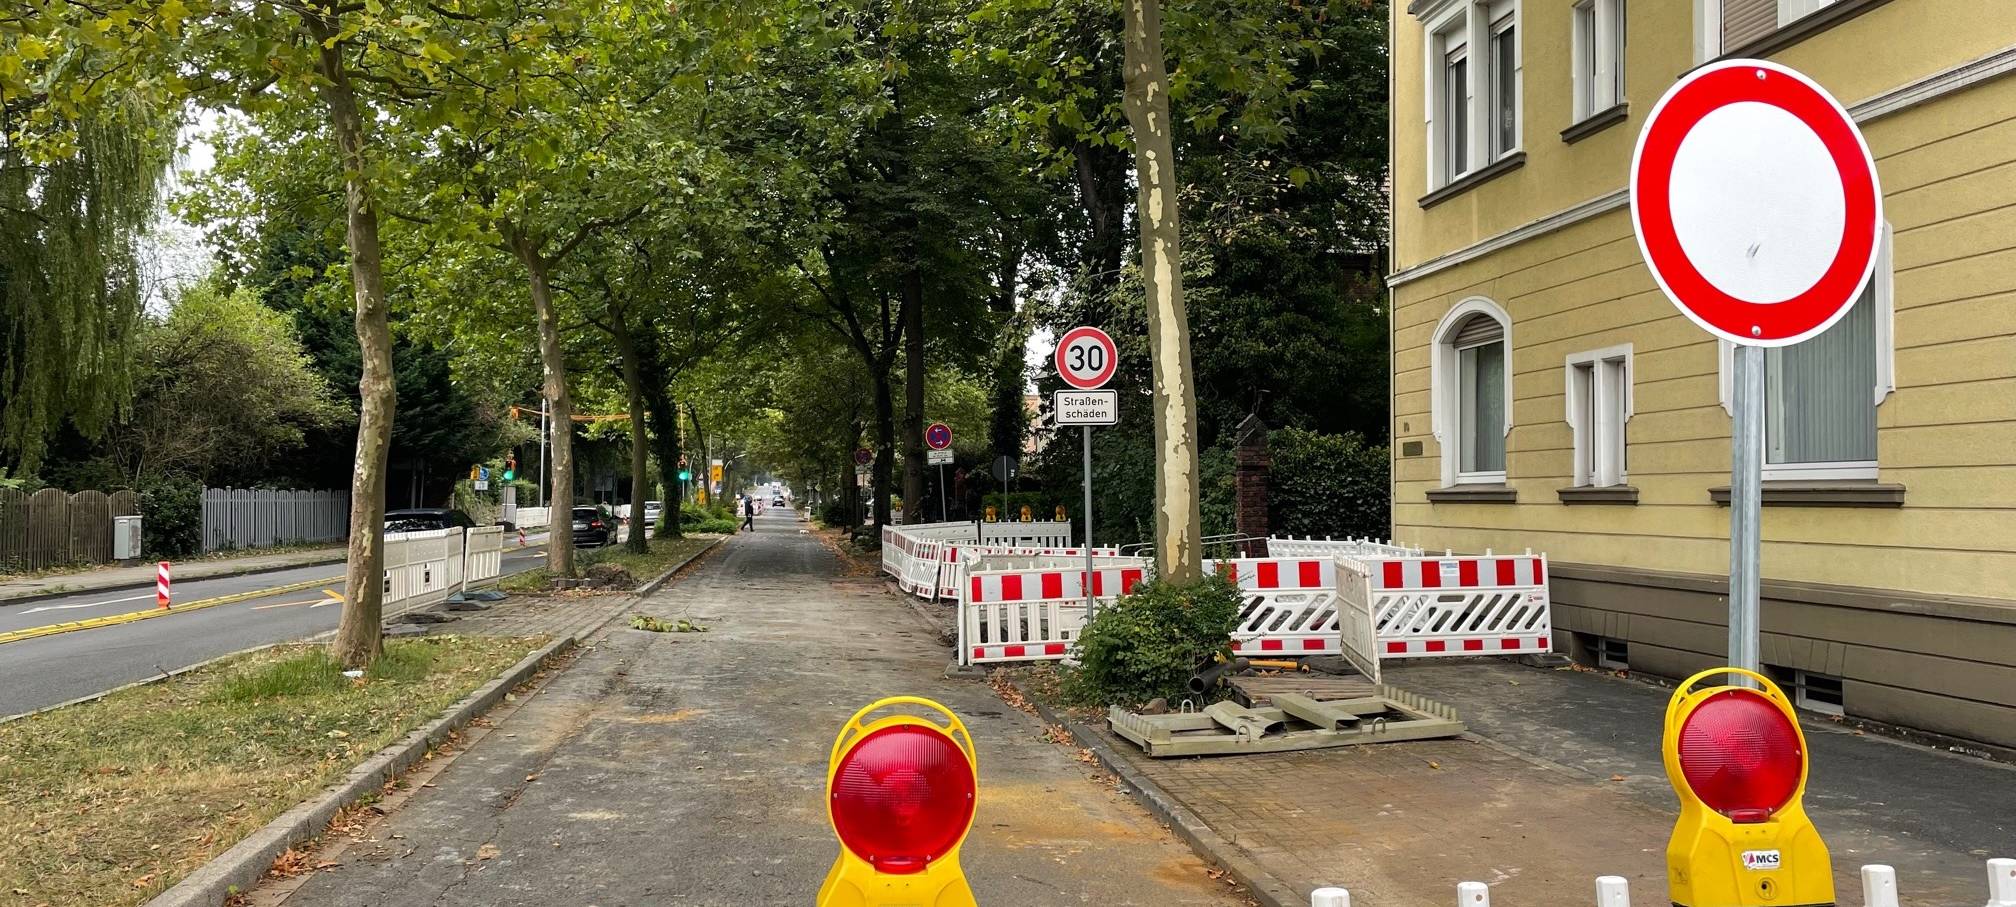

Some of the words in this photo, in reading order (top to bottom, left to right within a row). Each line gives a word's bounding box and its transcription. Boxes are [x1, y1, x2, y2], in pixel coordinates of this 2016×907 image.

[1069, 345, 1103, 371] 30
[1064, 396, 1109, 406] Straßen-
[1065, 409, 1107, 418] schäden
[1756, 854, 1779, 863] MCS
